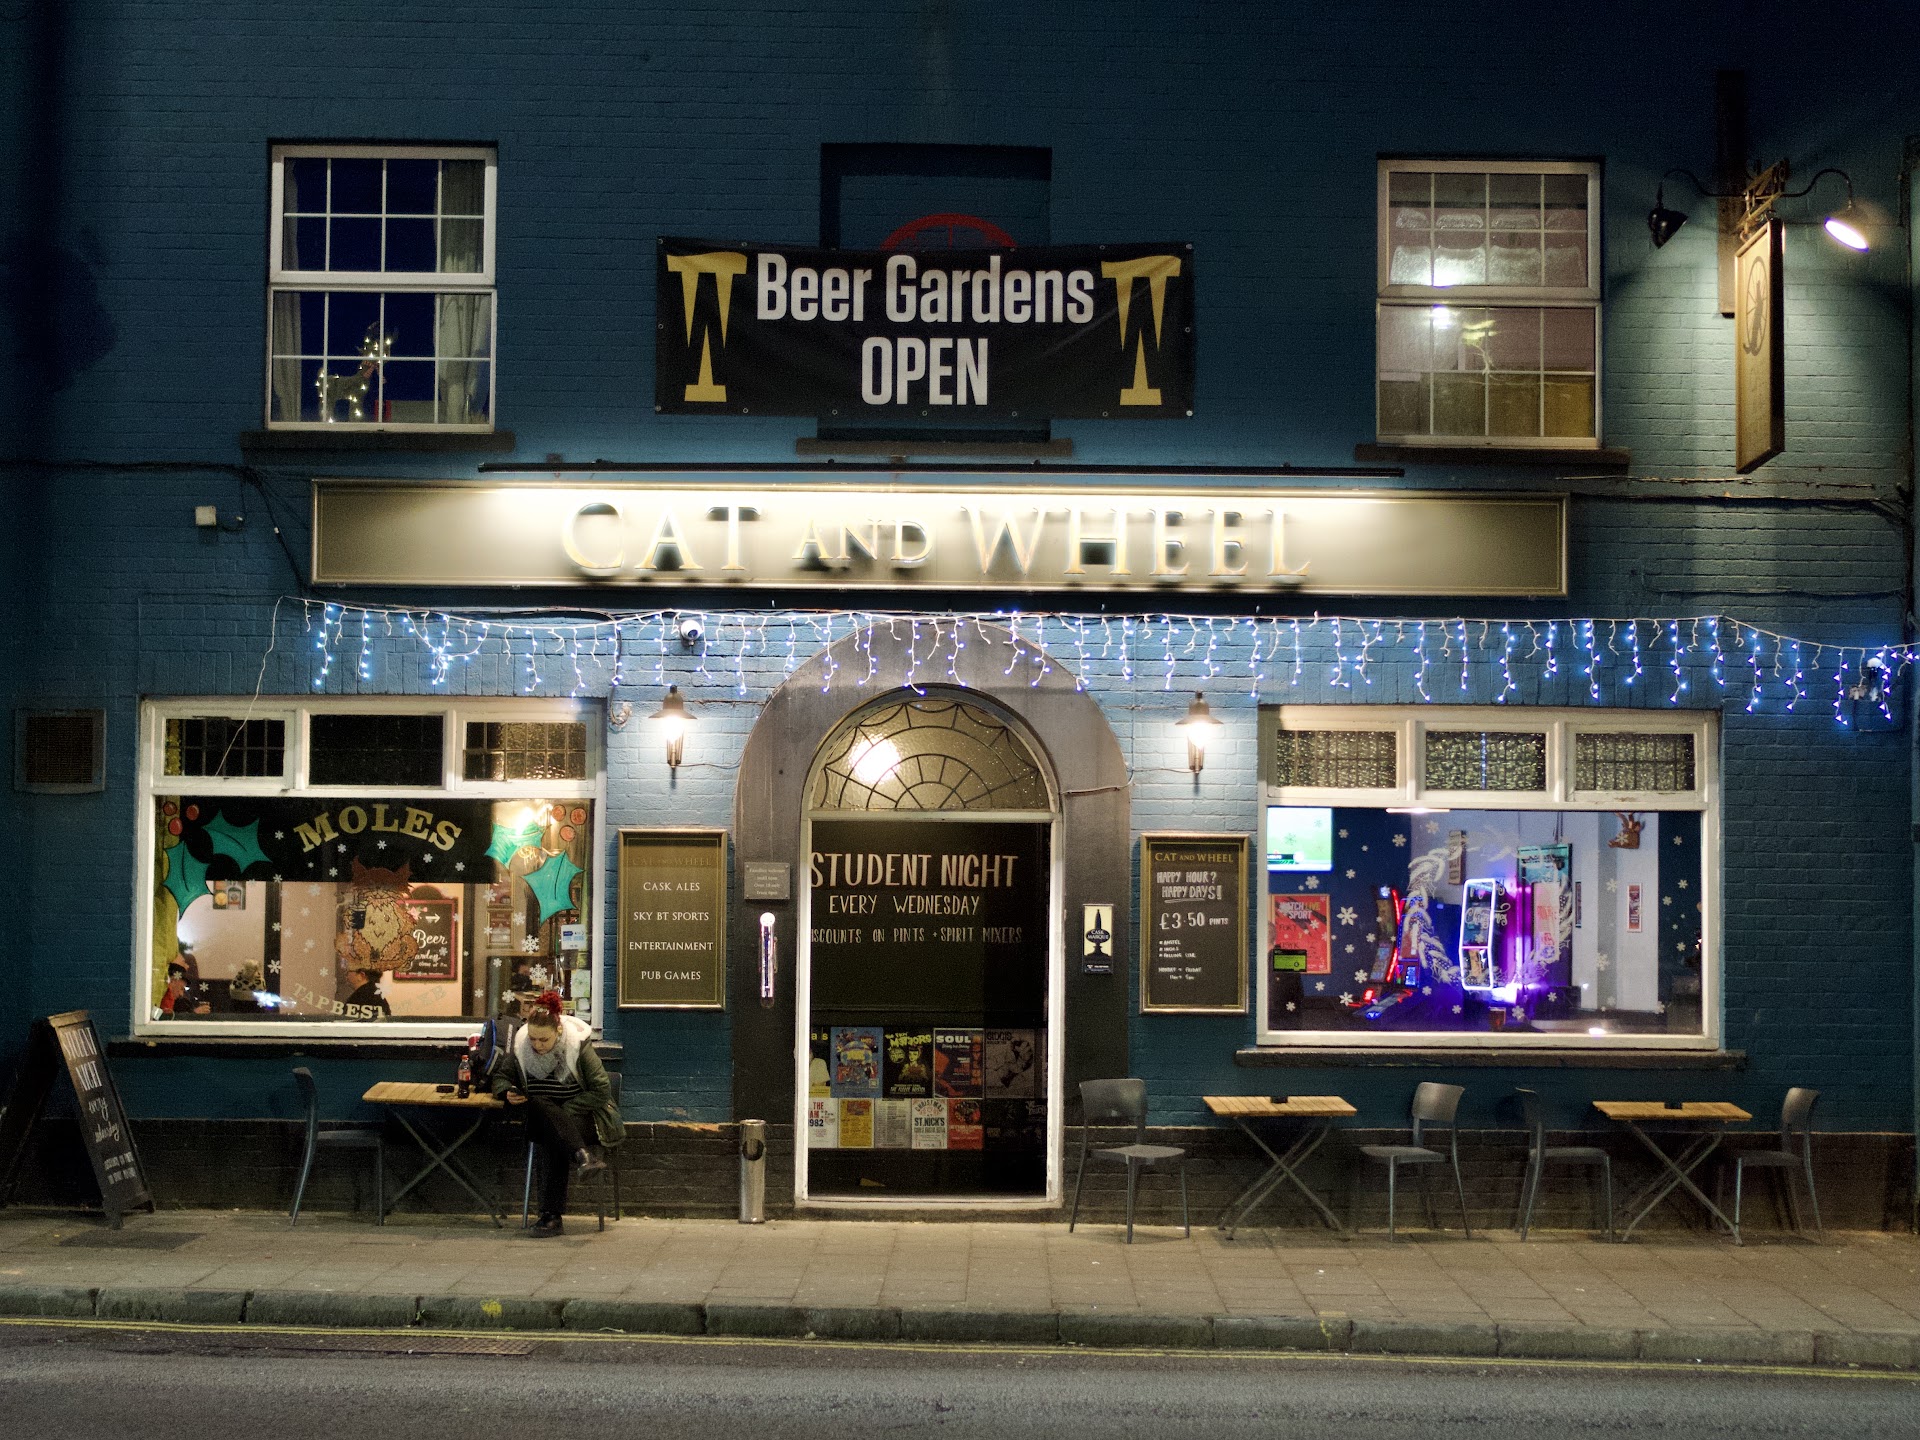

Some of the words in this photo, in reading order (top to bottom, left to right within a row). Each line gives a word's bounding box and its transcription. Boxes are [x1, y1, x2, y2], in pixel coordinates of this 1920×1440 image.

[757, 253, 872, 322] Beer
[885, 254, 1095, 324] Gardens
[861, 336, 989, 406] OPEN
[562, 502, 761, 570] CAT
[792, 518, 934, 566] AND
[960, 506, 1310, 577] WHEEL
[293, 803, 463, 853] MOLES
[1154, 852, 1177, 862] CAT
[1196, 853, 1234, 863] WHEEL
[811, 852, 932, 887] STUDENT
[940, 854, 1019, 888] NIGHT
[1156, 871, 1181, 884] HAPPY
[643, 882, 672, 891] CASK
[676, 882, 701, 891] ALES
[1161, 885, 1188, 898] HAPPY
[828, 895, 878, 915] EVERY
[893, 895, 980, 916] WEDNESDAY
[633, 912, 653, 921] SKY
[656, 912, 669, 921] BT
[672, 912, 710, 921] SPORTS
[1288, 910, 1313, 920] SPORT
[1208, 917, 1229, 926] PINTS
[413, 929, 448, 949] Beer
[811, 928, 862, 944] ISCOUNTS
[872, 928, 885, 942] ON
[893, 927, 925, 943] PINTS
[940, 927, 974, 943] SPIRIT
[982, 927, 1022, 944] MIXERS
[629, 941, 714, 951] ENTERTAINMENT
[641, 971, 661, 980] PUB
[664, 971, 701, 980] GAMES
[935, 1035, 972, 1044] SOUL
[812, 1101, 824, 1110] THE
[809, 1110, 820, 1119] AM
[809, 1118, 824, 1127] 982
